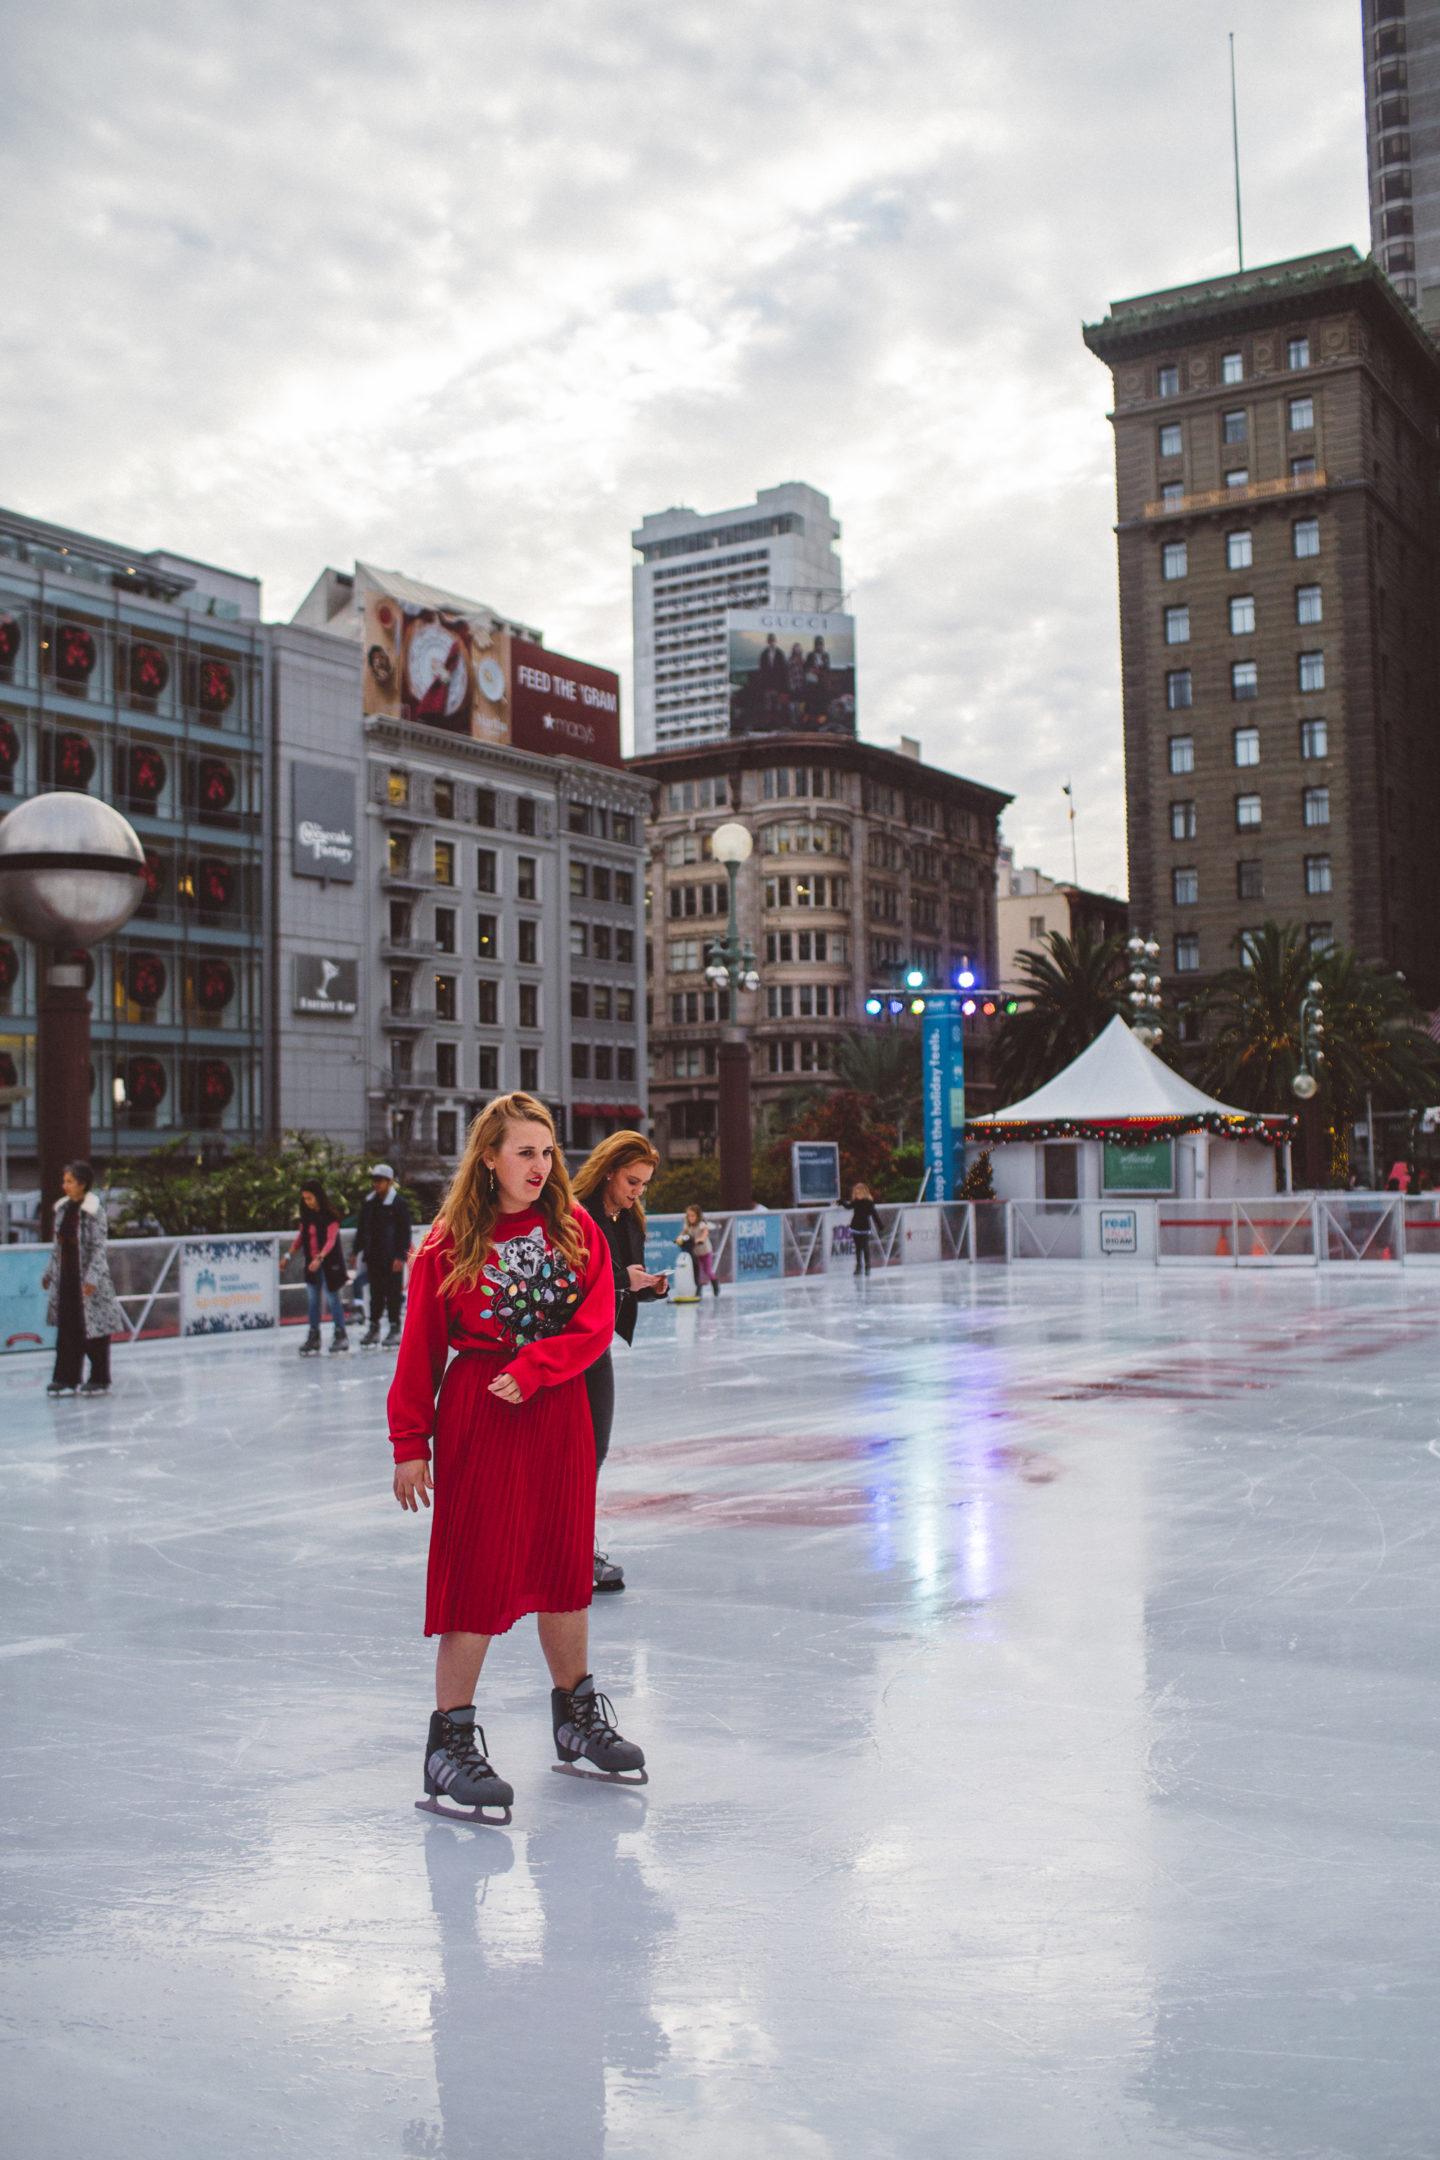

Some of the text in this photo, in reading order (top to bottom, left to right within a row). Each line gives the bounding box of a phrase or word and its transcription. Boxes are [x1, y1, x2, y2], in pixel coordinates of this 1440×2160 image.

[762, 615, 828, 630] GUCCI
[518, 664, 617, 712] FEED THE 'GRAM
[929, 1028, 940, 1067] feels.
[930, 1068, 943, 1117] holiday
[931, 1120, 943, 1139] the
[932, 1140, 943, 1157] all
[934, 1159, 944, 1173] to
[738, 1219, 767, 1237] DEAR
[1104, 1216, 1131, 1228] real
[738, 1236, 765, 1252] EVAN
[738, 1252, 779, 1270] HANSEN
